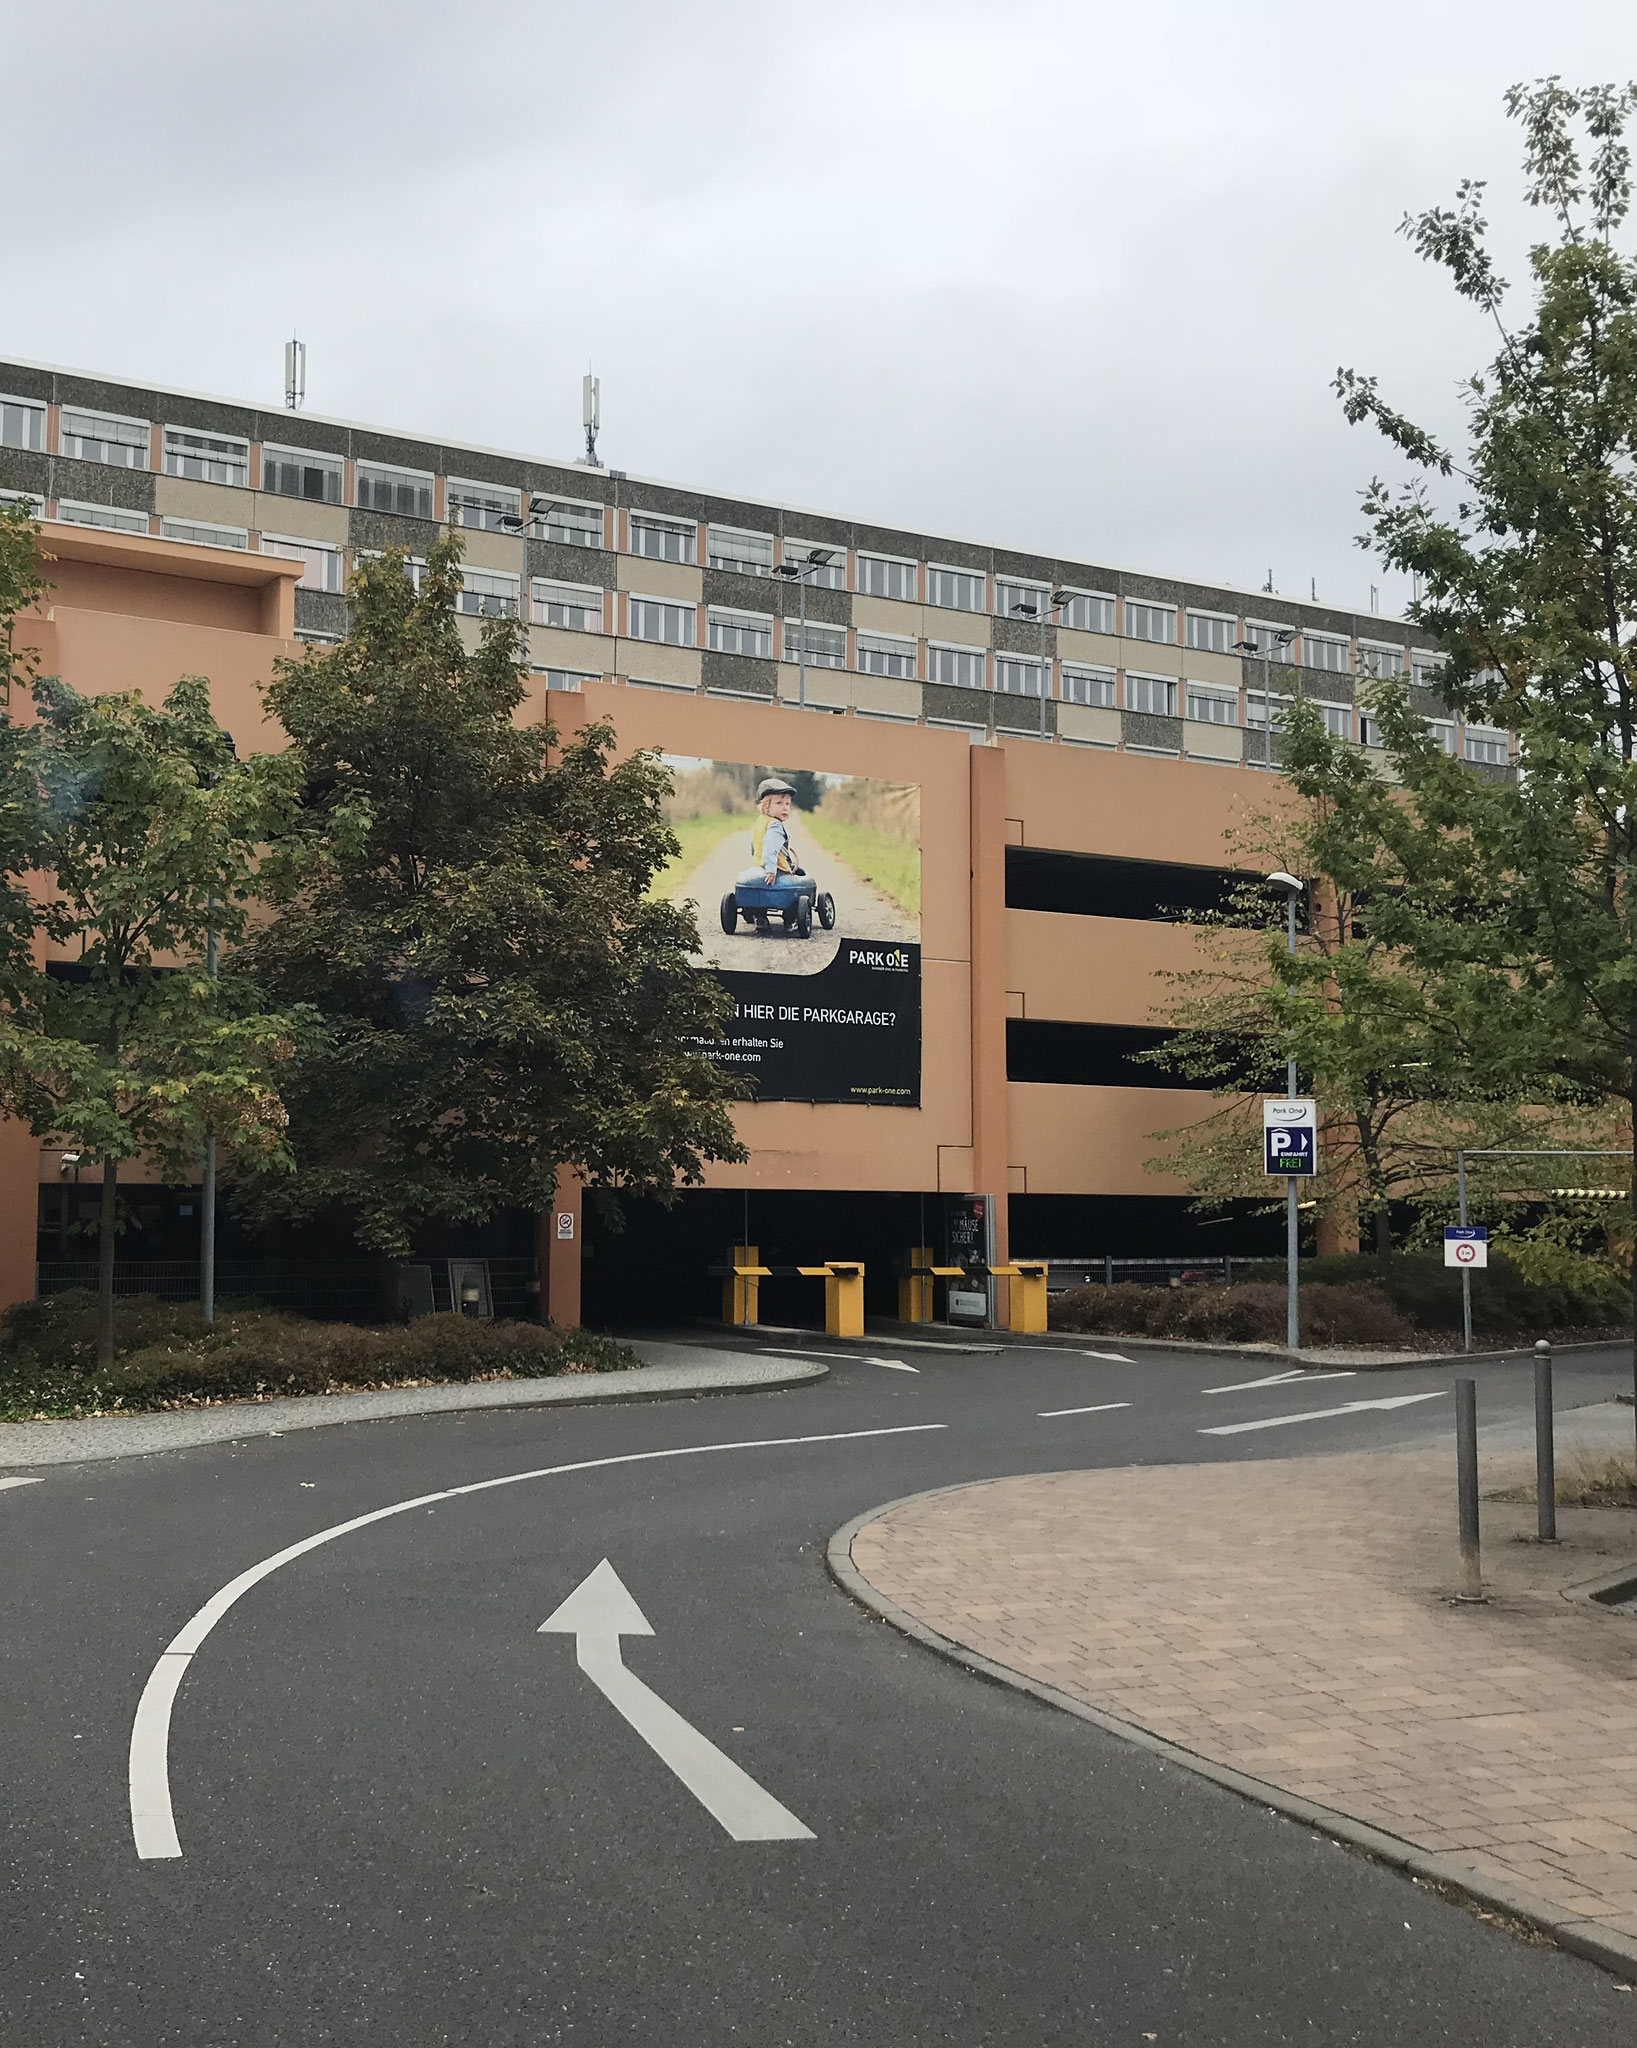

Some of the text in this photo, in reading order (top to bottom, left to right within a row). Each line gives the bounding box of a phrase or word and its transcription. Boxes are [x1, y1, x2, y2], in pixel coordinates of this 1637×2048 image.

[849, 950, 884, 965] PARK
[744, 1004, 774, 1019] HIER
[779, 1006, 800, 1020] DIE
[804, 1007, 896, 1026] PARKGARAGE?
[733, 1037, 768, 1048] erhalten
[770, 1038, 784, 1049] Sie
[850, 1086, 911, 1096] www.park-one.com
[1271, 1132, 1291, 1157] P
[1279, 1158, 1302, 1168] FREI
